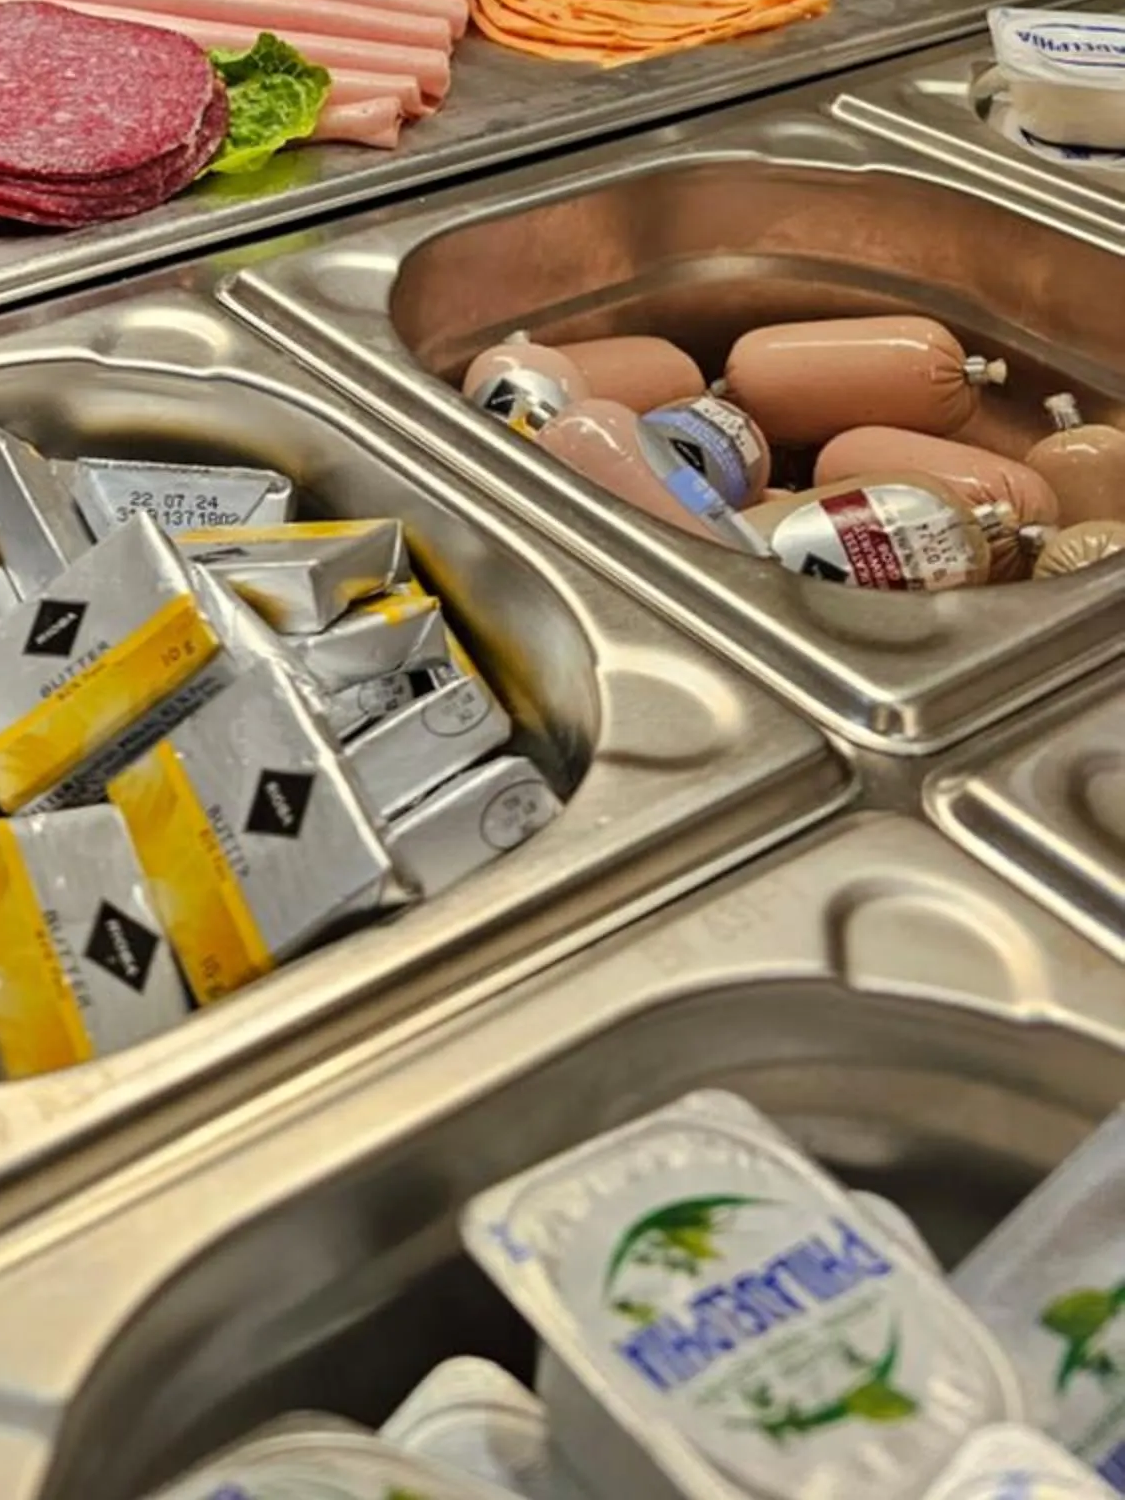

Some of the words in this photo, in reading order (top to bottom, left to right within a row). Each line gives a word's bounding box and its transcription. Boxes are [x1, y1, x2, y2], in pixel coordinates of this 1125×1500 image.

[34, 611, 77, 645] RIOBA
[39, 640, 111, 699] BUTTER
[265, 780, 295, 828] RIOBA
[206, 803, 250, 878] BUTTER
[104, 917, 141, 978] RIOBA
